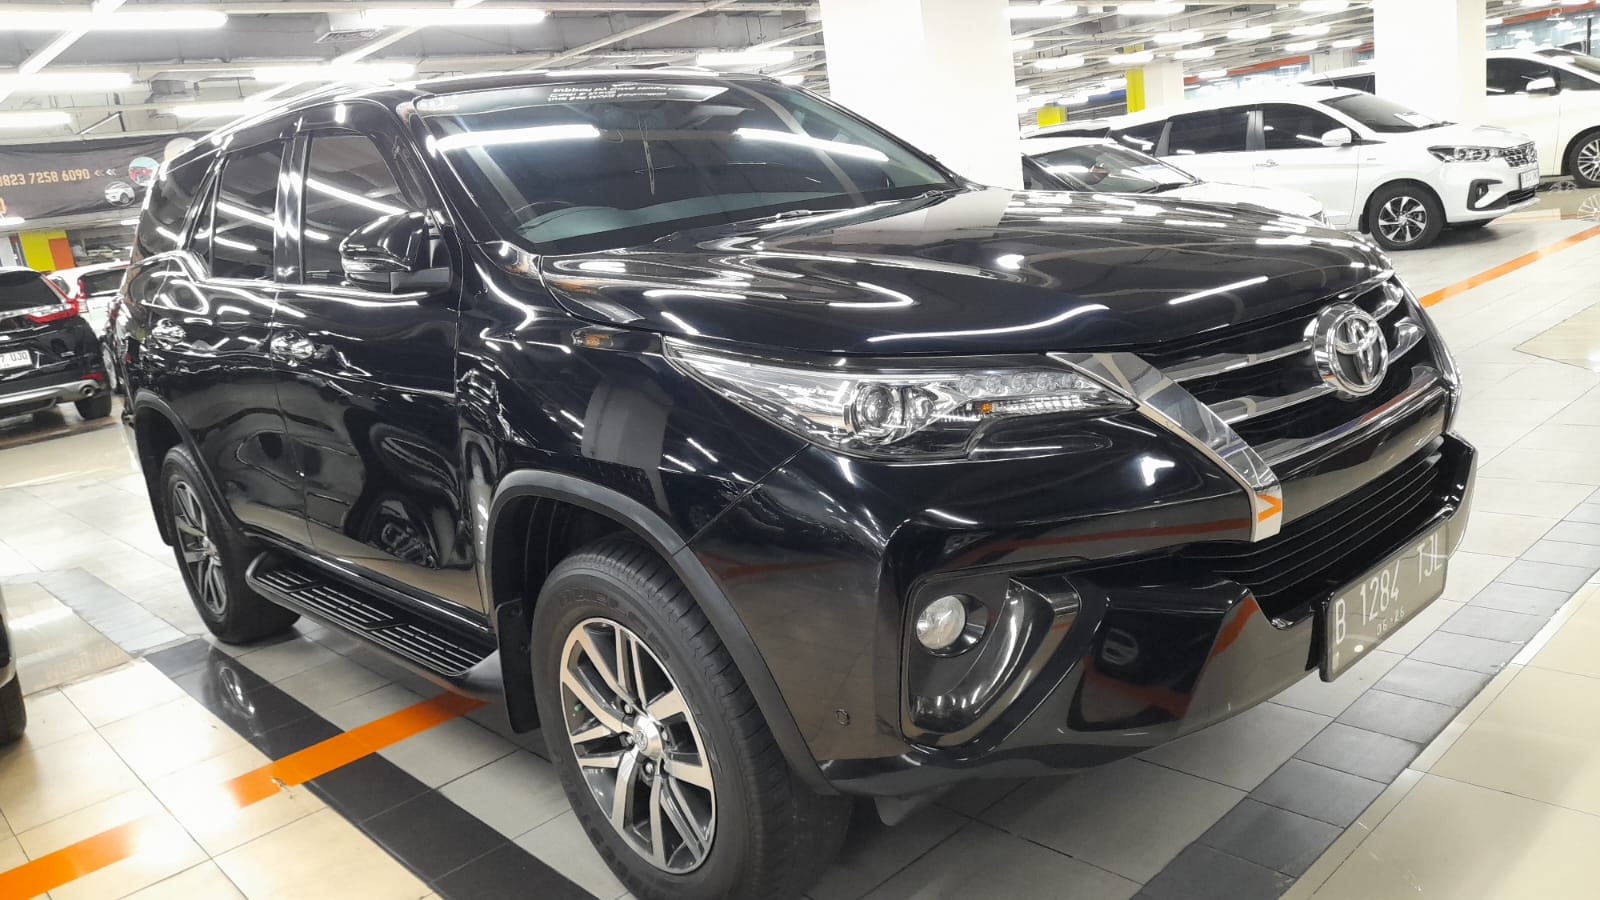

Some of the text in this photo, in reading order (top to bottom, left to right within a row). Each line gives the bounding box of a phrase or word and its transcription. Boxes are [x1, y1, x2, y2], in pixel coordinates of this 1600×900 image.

[28, 171, 59, 184] 7258
[61, 168, 91, 182] 6090
[1335, 532, 1442, 645] B 1284 TJL
